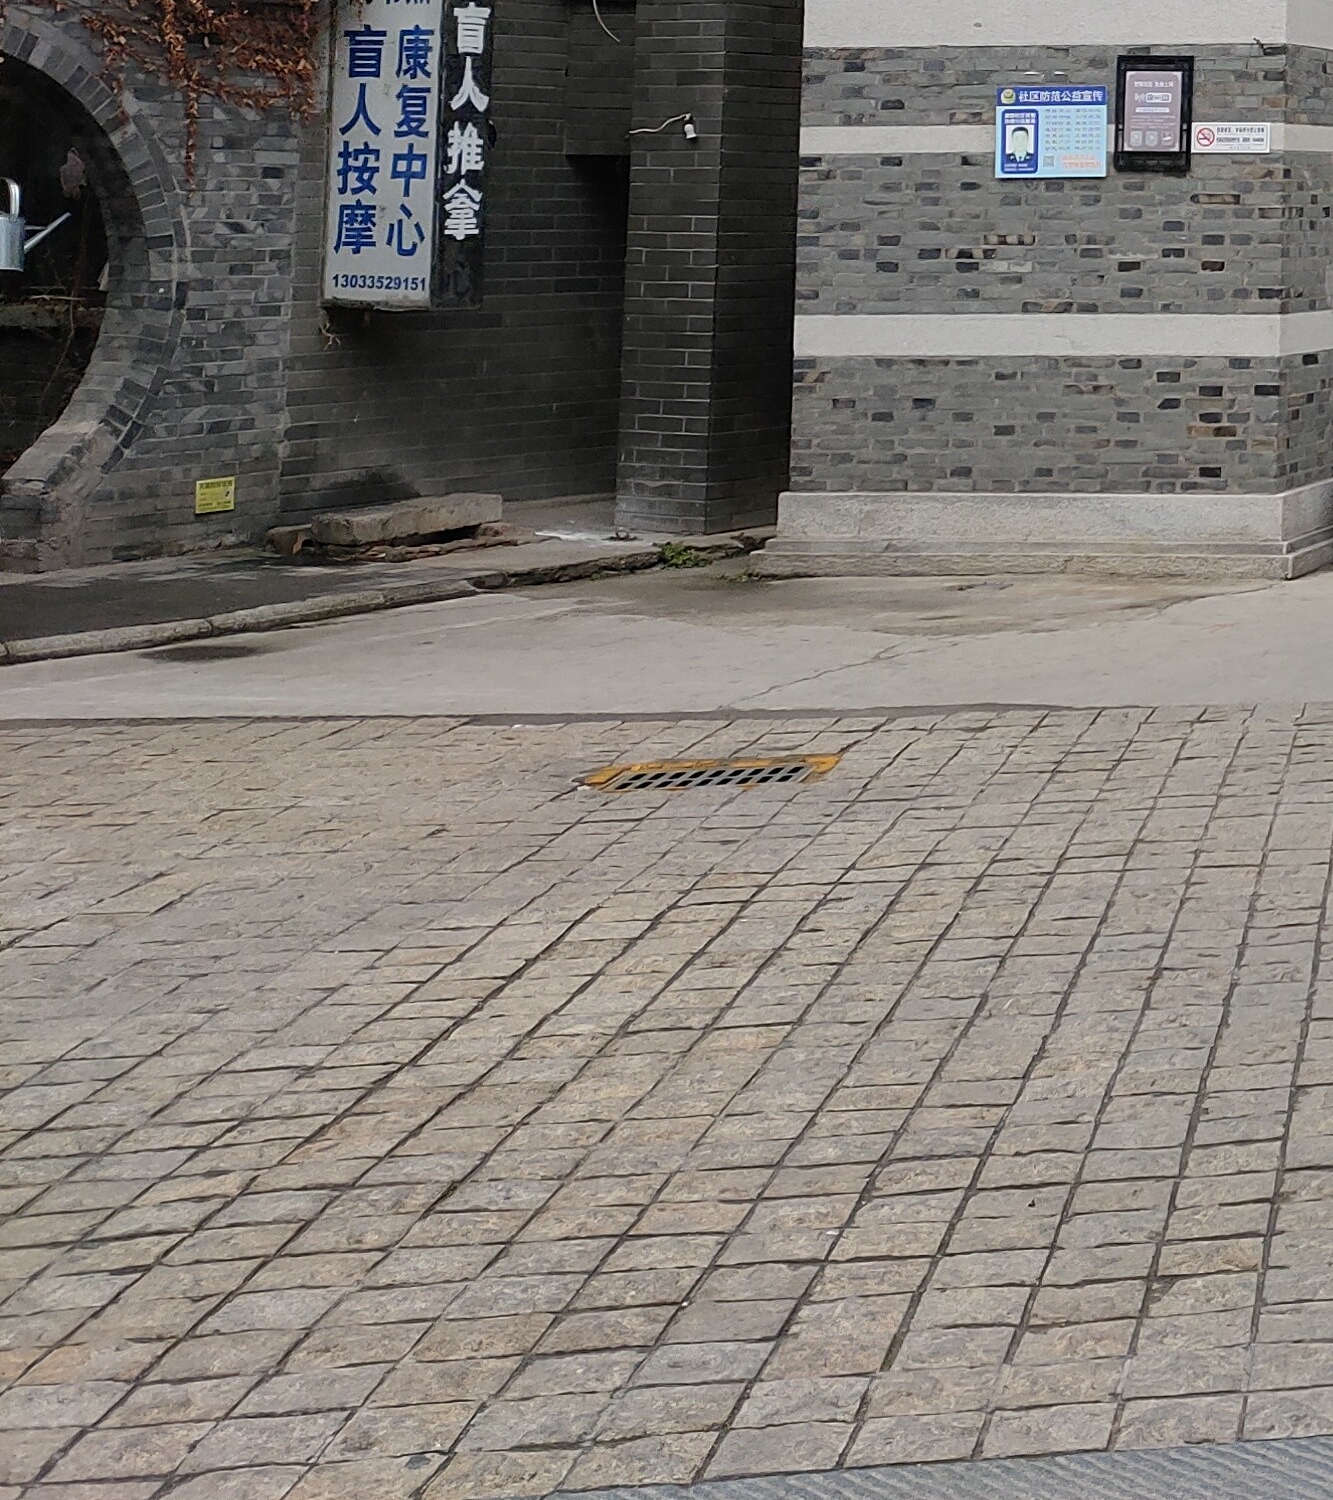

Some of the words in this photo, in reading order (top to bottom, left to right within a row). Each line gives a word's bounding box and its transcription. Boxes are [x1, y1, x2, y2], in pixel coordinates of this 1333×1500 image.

[333, 24, 387, 256] 盲人按摩
[386, 24, 435, 257] 康复中心
[442, 3, 489, 241] 盲人推拿
[1018, 90, 1104, 102] 社区防范公益宣传
[332, 274, 426, 293] 13033529151
